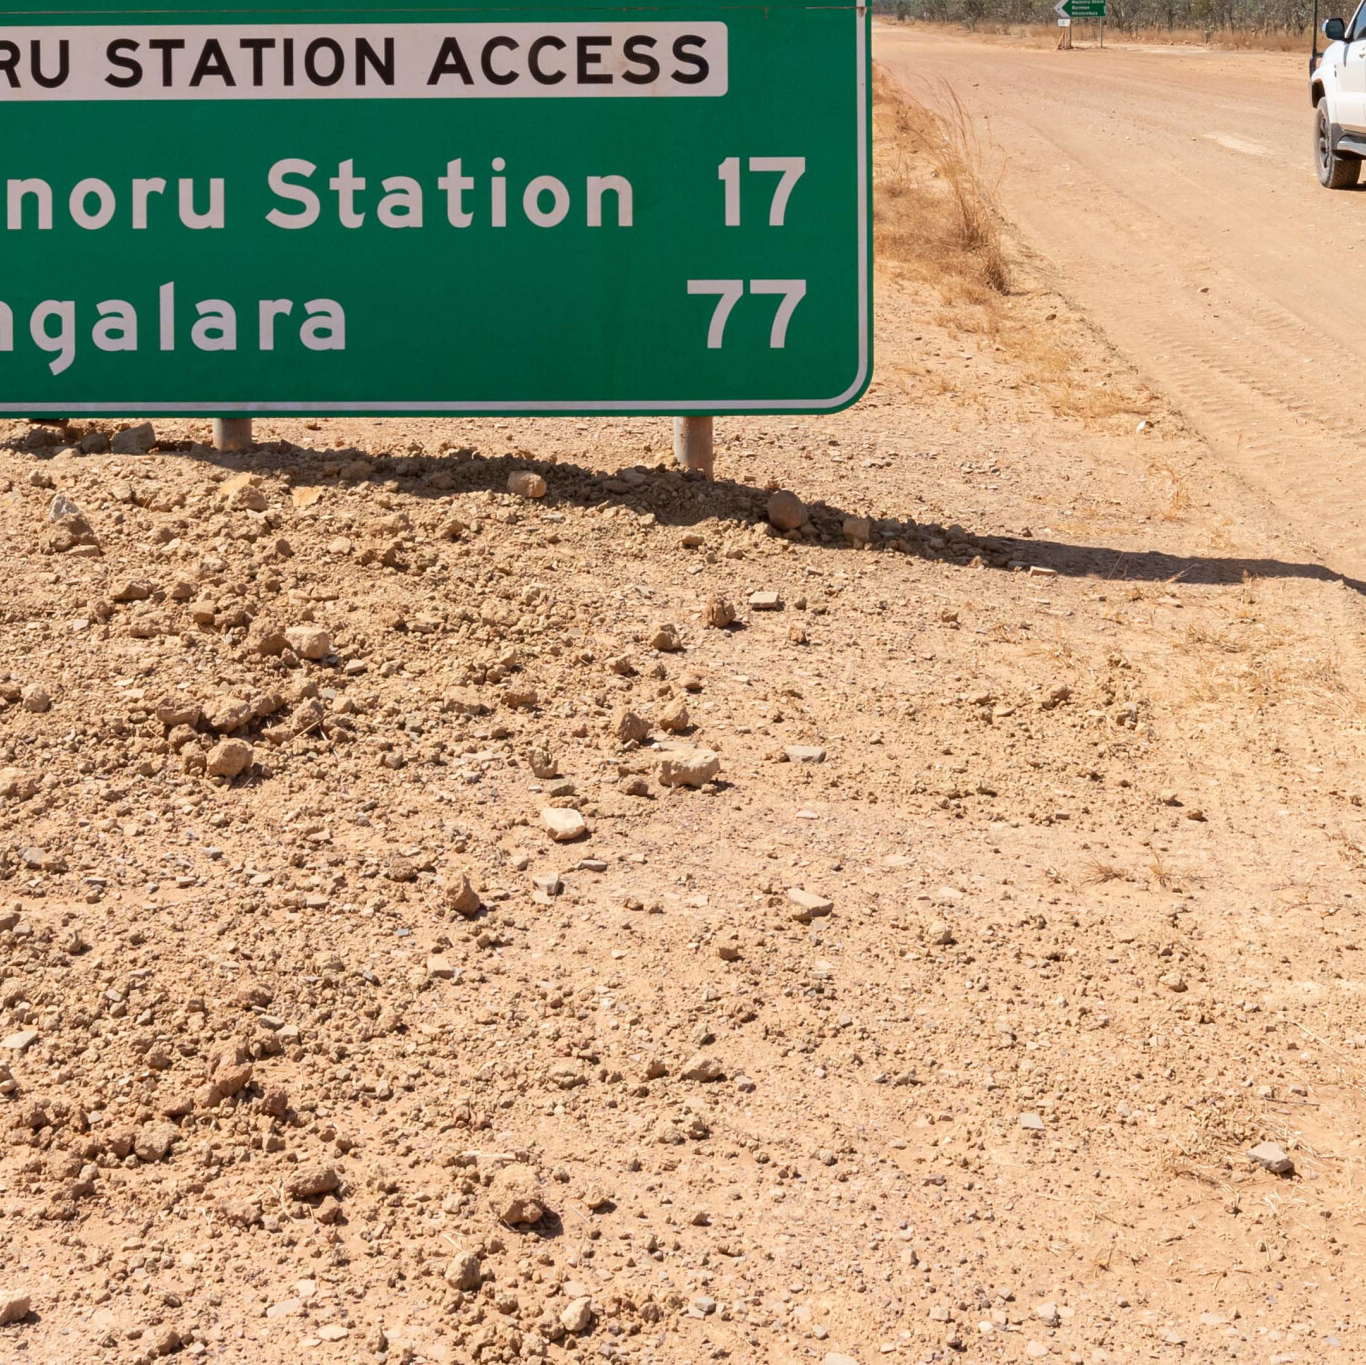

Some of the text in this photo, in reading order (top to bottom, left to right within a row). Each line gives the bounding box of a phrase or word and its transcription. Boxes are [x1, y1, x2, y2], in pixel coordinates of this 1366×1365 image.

[105, 38, 395, 88] STATION
[427, 35, 710, 85] ACCESS
[266, 157, 633, 230] Station
[718, 157, 806, 227] 17
[687, 280, 807, 349] 77
